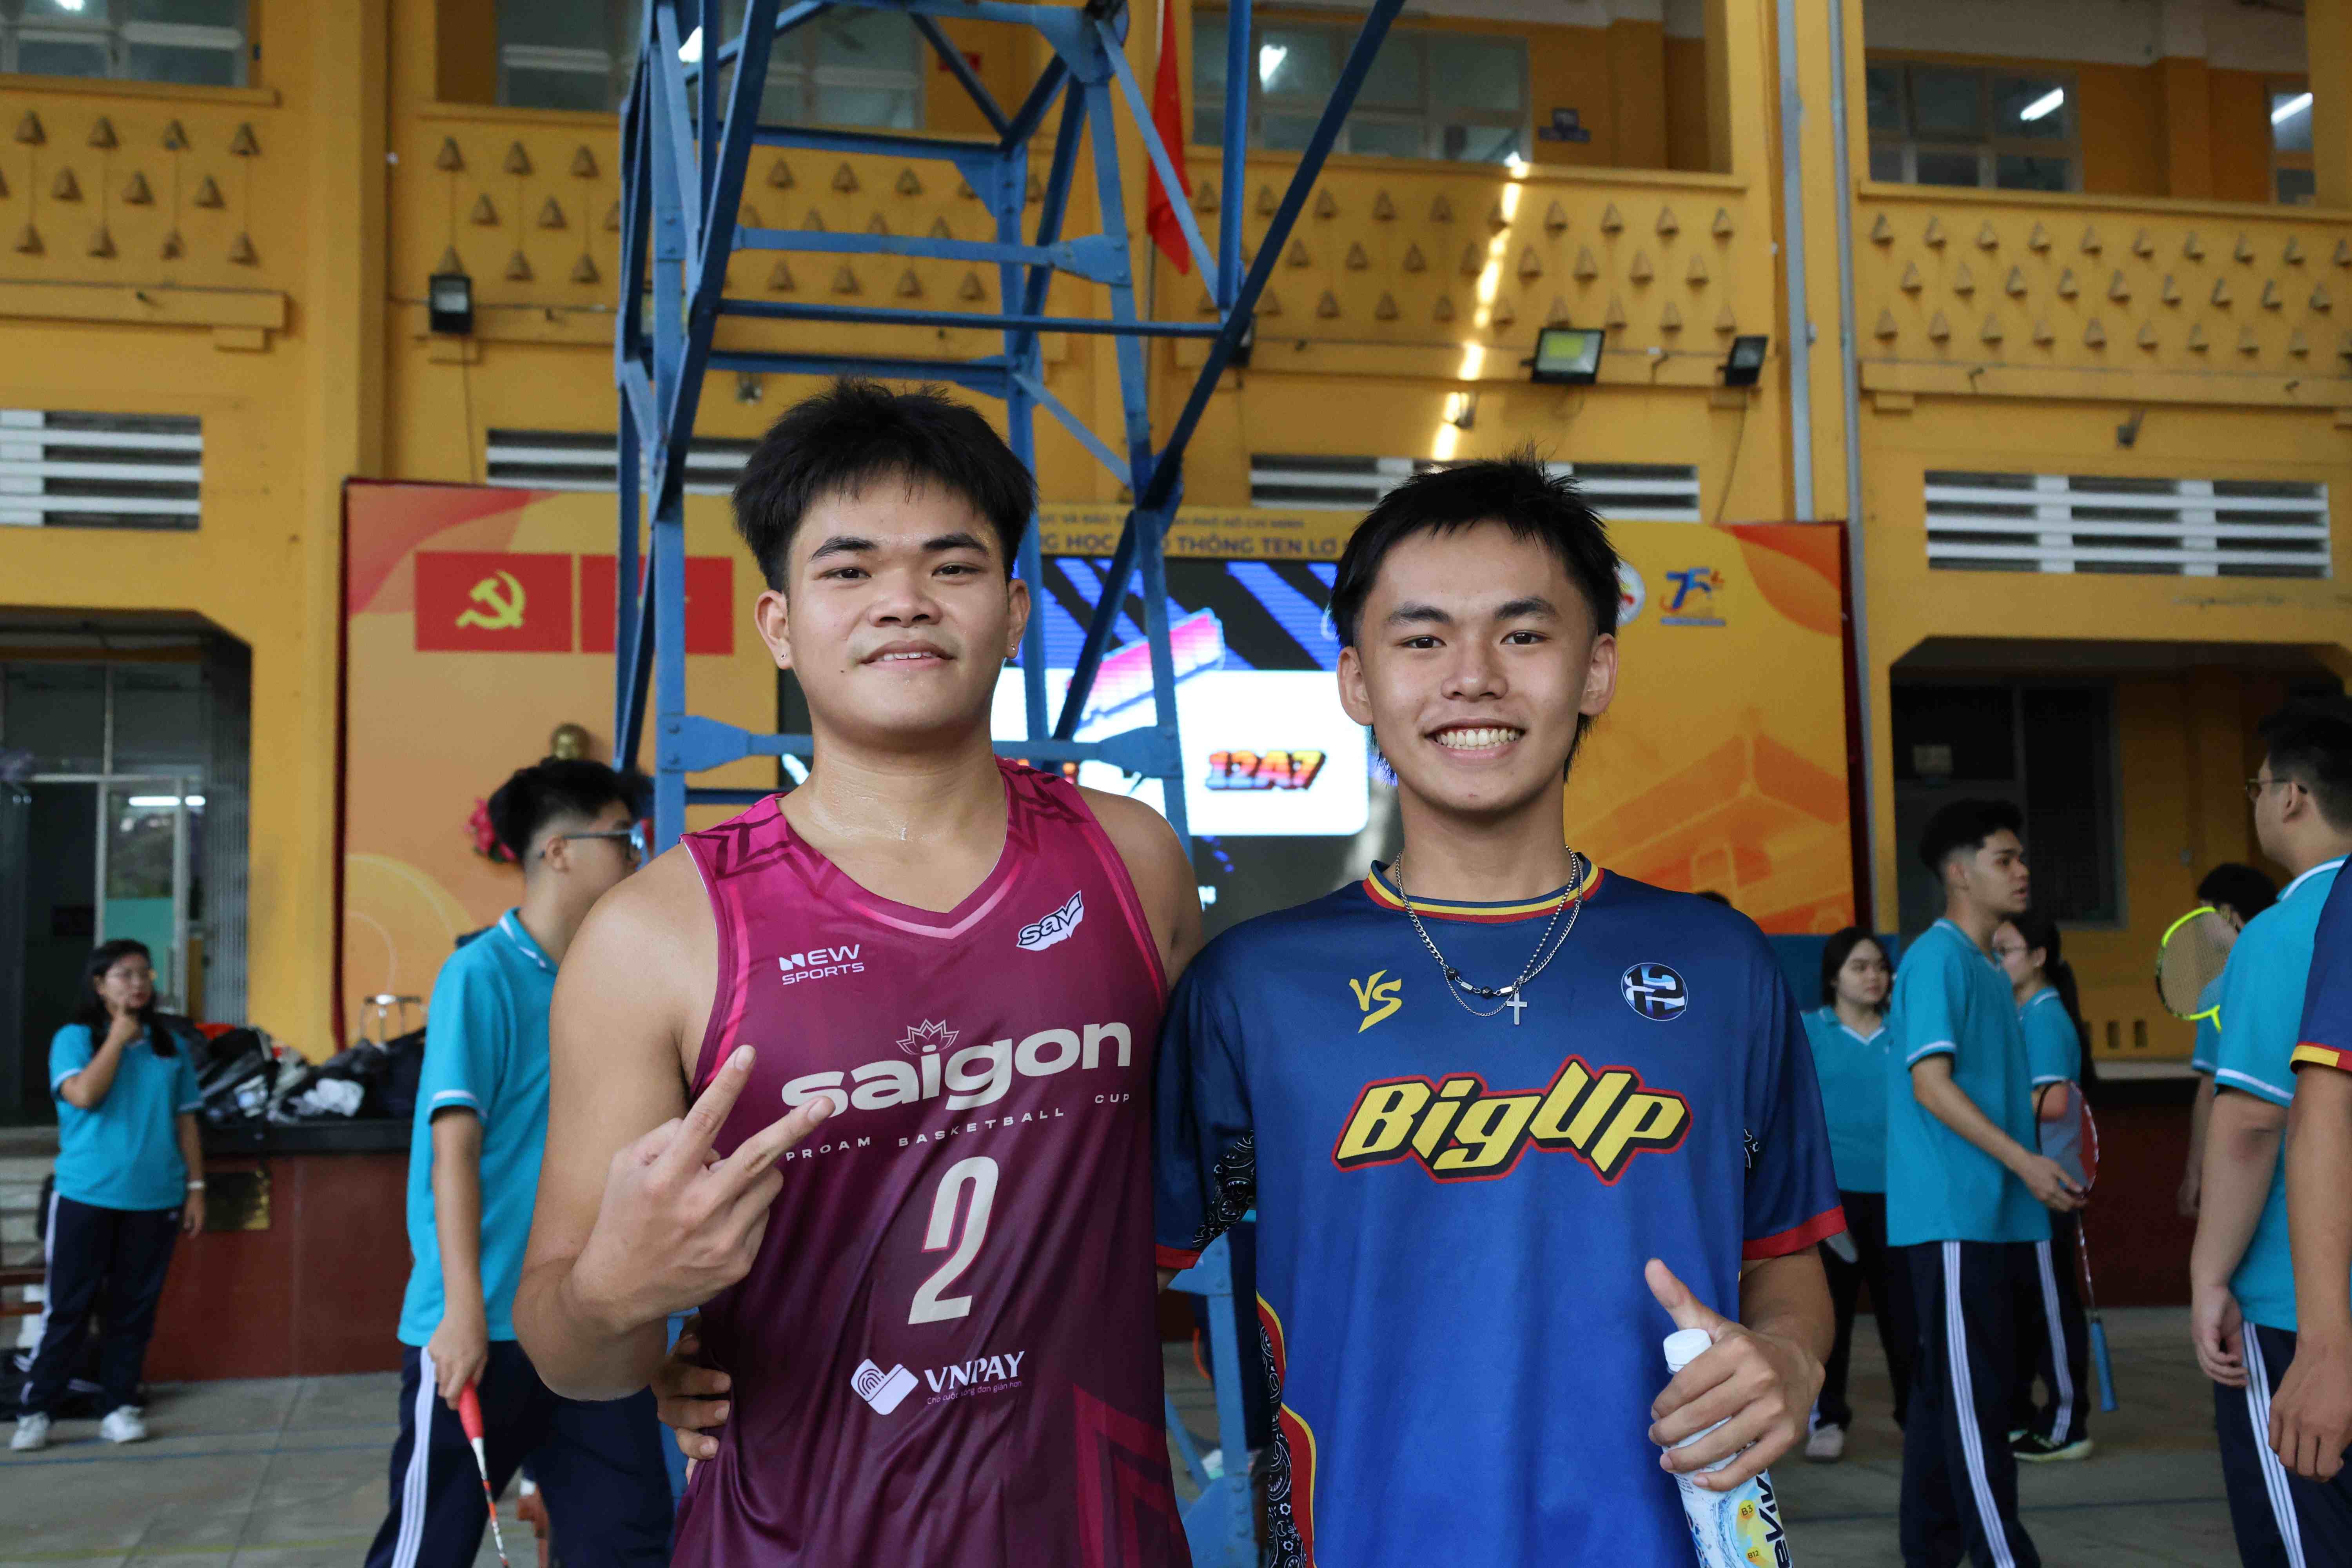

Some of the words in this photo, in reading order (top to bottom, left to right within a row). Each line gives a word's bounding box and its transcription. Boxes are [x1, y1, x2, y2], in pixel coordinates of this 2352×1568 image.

[779, 944, 860, 971] NEW
[782, 962, 865, 985] SPORTS
[1349, 969, 1402, 1033] VS
[782, 1022, 1131, 1118] saigon
[786, 1136, 871, 1161] PROAM
[898, 1108, 1064, 1147] BASKETBALL
[1094, 1093, 1130, 1104] CUP
[1334, 1058, 1690, 1182] BigUp
[907, 1156, 999, 1325] 2
[924, 1350, 1025, 1393] VNPAY
[927, 1396, 941, 1405] Cho
[1741, 1504, 1753, 1516] B3
[1747, 1550, 1760, 1559] B12
